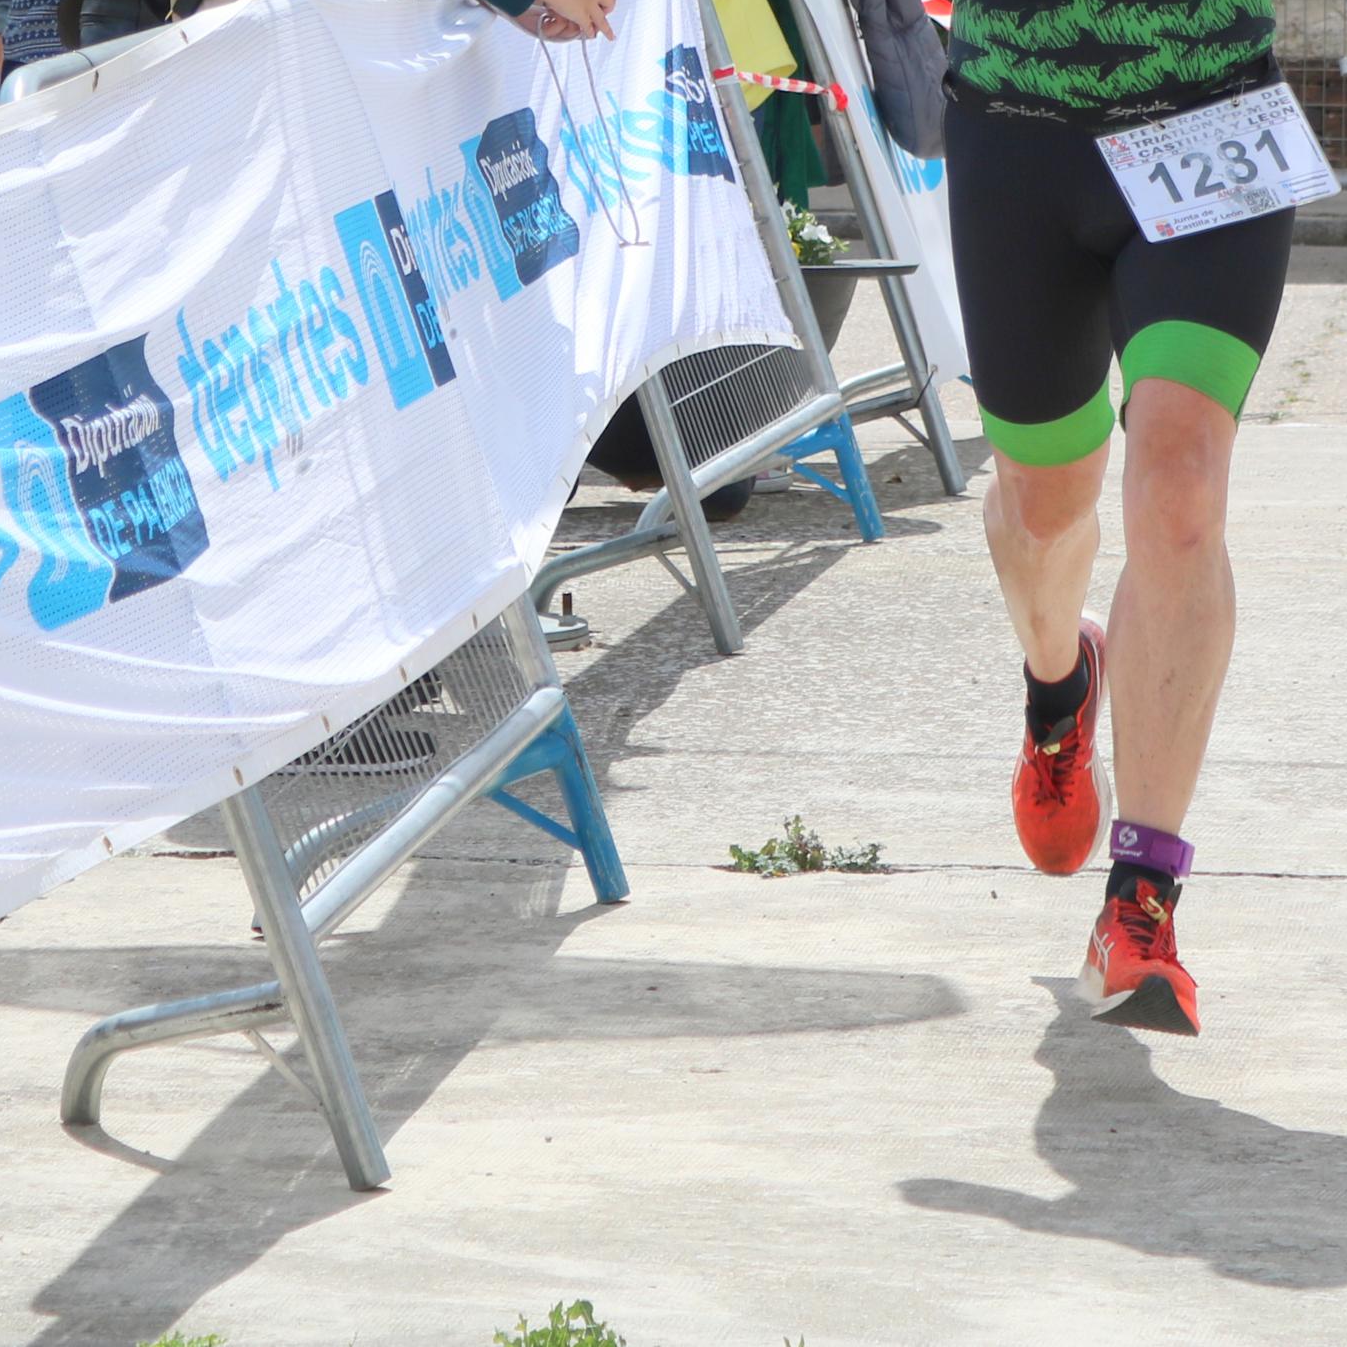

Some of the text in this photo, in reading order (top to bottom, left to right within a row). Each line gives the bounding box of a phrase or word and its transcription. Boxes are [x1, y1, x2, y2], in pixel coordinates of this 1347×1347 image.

[1261, 86, 1286, 100] DE
[1267, 95, 1292, 108] DE
[1103, 99, 1177, 122] Spiuk
[1137, 128, 1225, 158] CASTILLA
[1248, 105, 1296, 126] LEON
[1148, 129, 1291, 204] 1231
[1173, 208, 1214, 225] Junta de
[1175, 217, 1211, 233] Castilla
[1219, 208, 1245, 221] León
[176, 260, 370, 490] deportes
[87, 500, 132, 560] DE
